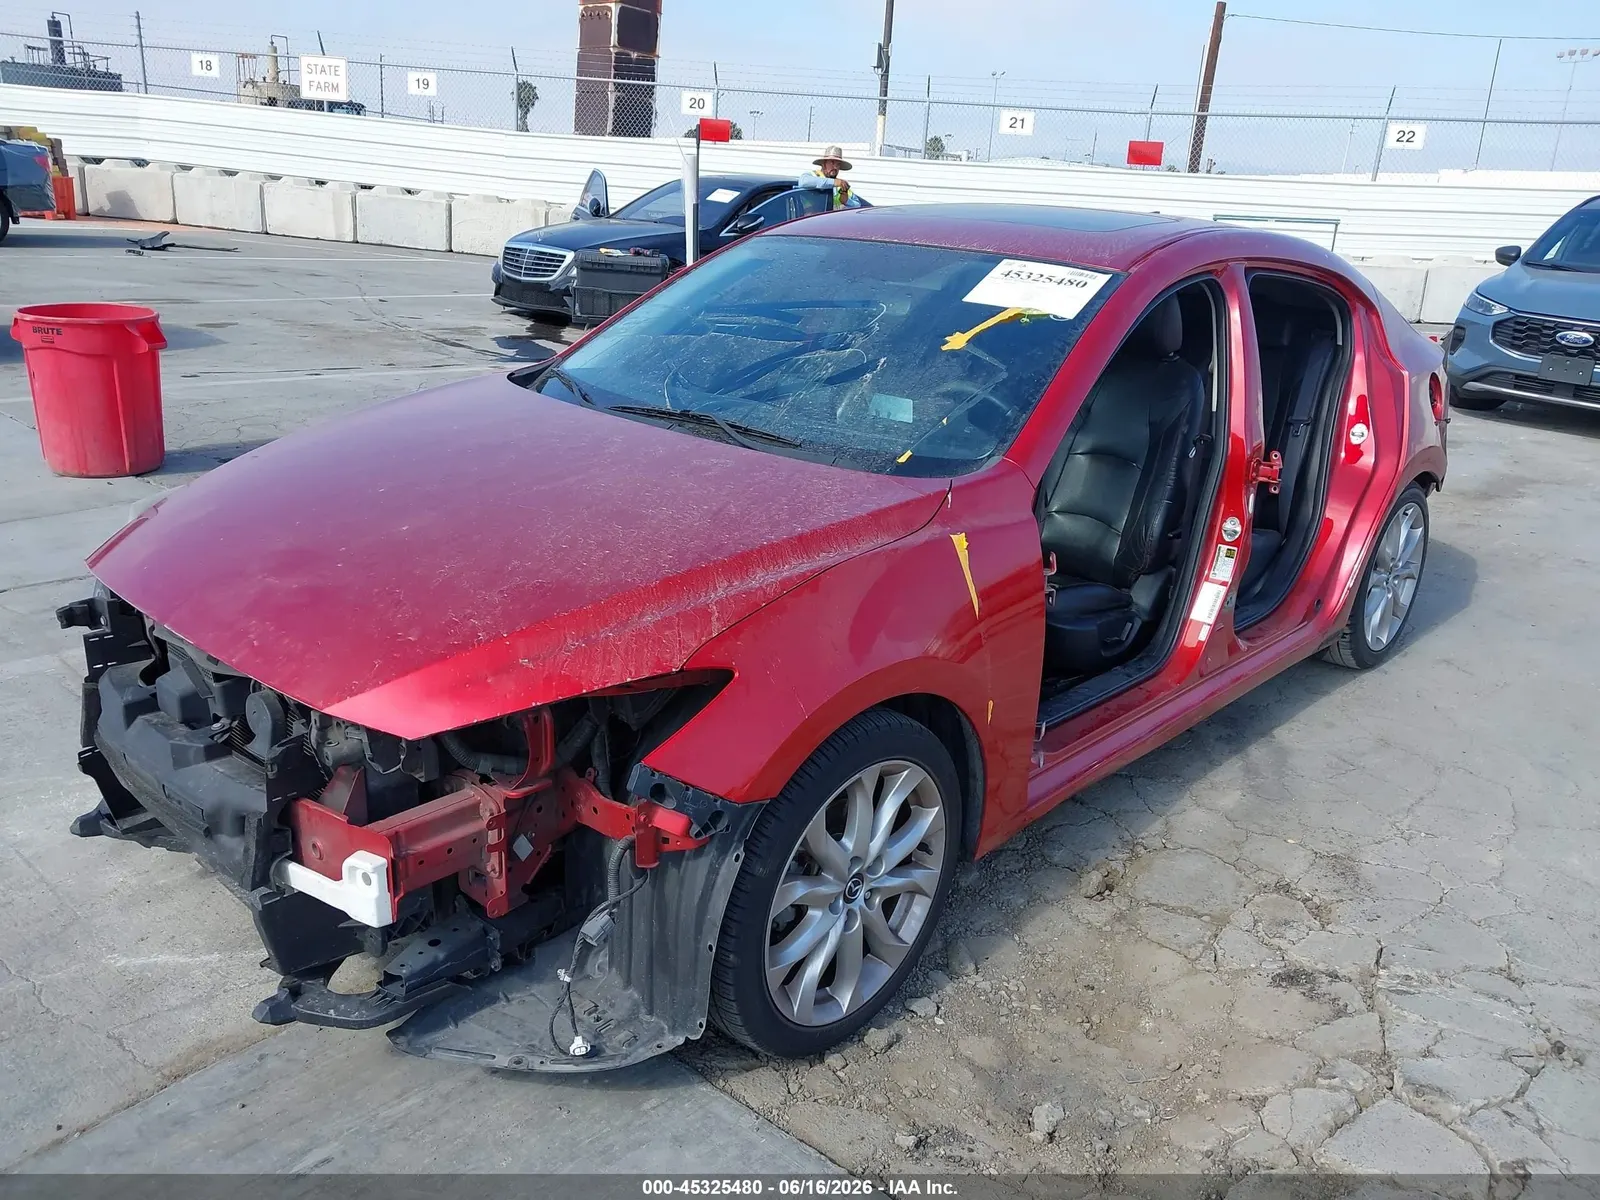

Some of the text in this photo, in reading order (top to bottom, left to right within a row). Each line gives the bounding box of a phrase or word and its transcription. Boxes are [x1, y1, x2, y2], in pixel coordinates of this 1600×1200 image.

[198, 60, 213, 72] 18
[306, 63, 341, 77] STATE
[308, 80, 340, 93] FARM
[414, 78, 430, 90] 19
[689, 97, 705, 110] 20
[1009, 116, 1025, 129] 21
[1396, 130, 1416, 143] 22
[1000, 269, 1088, 289] 45325480
[32, 325, 63, 336] BRUTE
